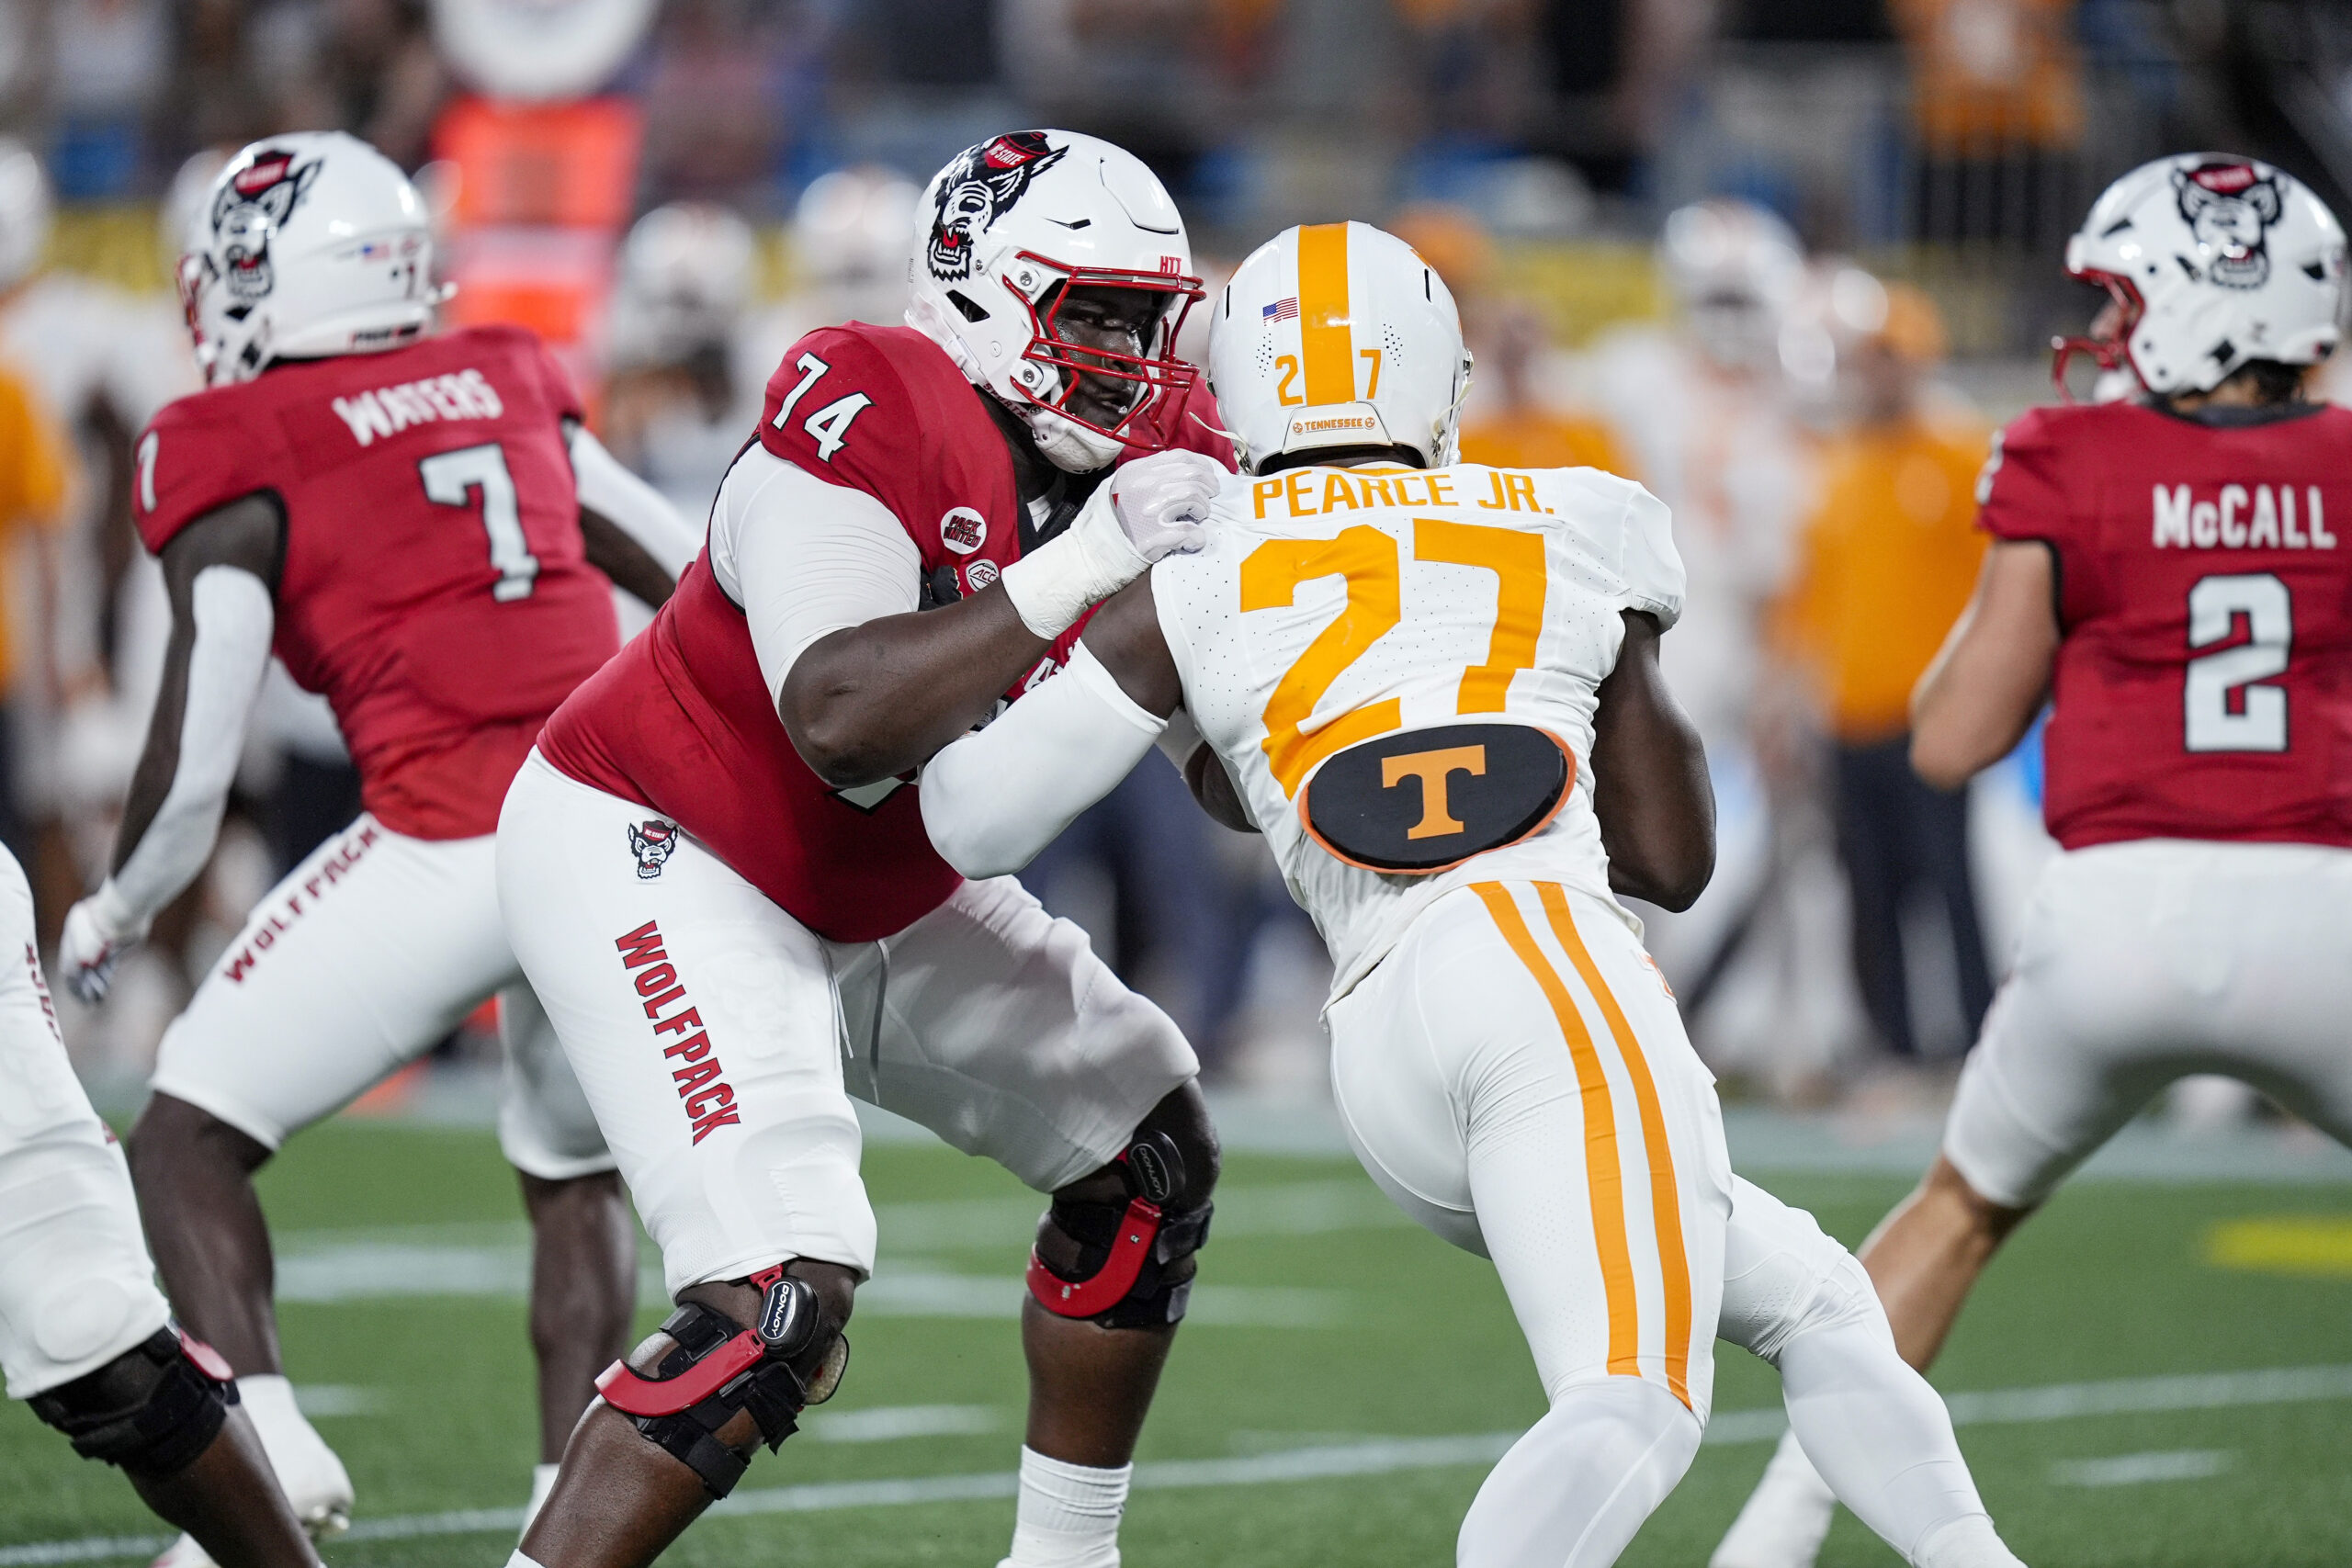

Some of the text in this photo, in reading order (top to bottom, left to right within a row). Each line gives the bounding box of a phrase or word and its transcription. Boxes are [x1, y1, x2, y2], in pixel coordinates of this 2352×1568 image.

[994, 149, 1026, 165] STATE
[1159, 255, 1182, 274] HTT
[331, 367, 503, 447] WATERS
[770, 350, 877, 464] 74
[1305, 418, 1363, 431] TENNESSEE
[416, 441, 540, 604] 7
[1252, 469, 1555, 519] PEARCE JR.
[2152, 483, 2337, 549] McCALL
[943, 525, 982, 548] UNITED
[948, 514, 981, 535] PACK
[972, 569, 997, 583] ACC
[1239, 517, 1547, 802] 27
[2184, 573, 2292, 753] 2
[1381, 744, 1487, 840] T
[224, 827, 379, 983] WOLFPACK
[615, 919, 741, 1147] WOLFPACK
[1138, 1147, 1166, 1196] DONJOY
[771, 1284, 790, 1337] DONJOY
